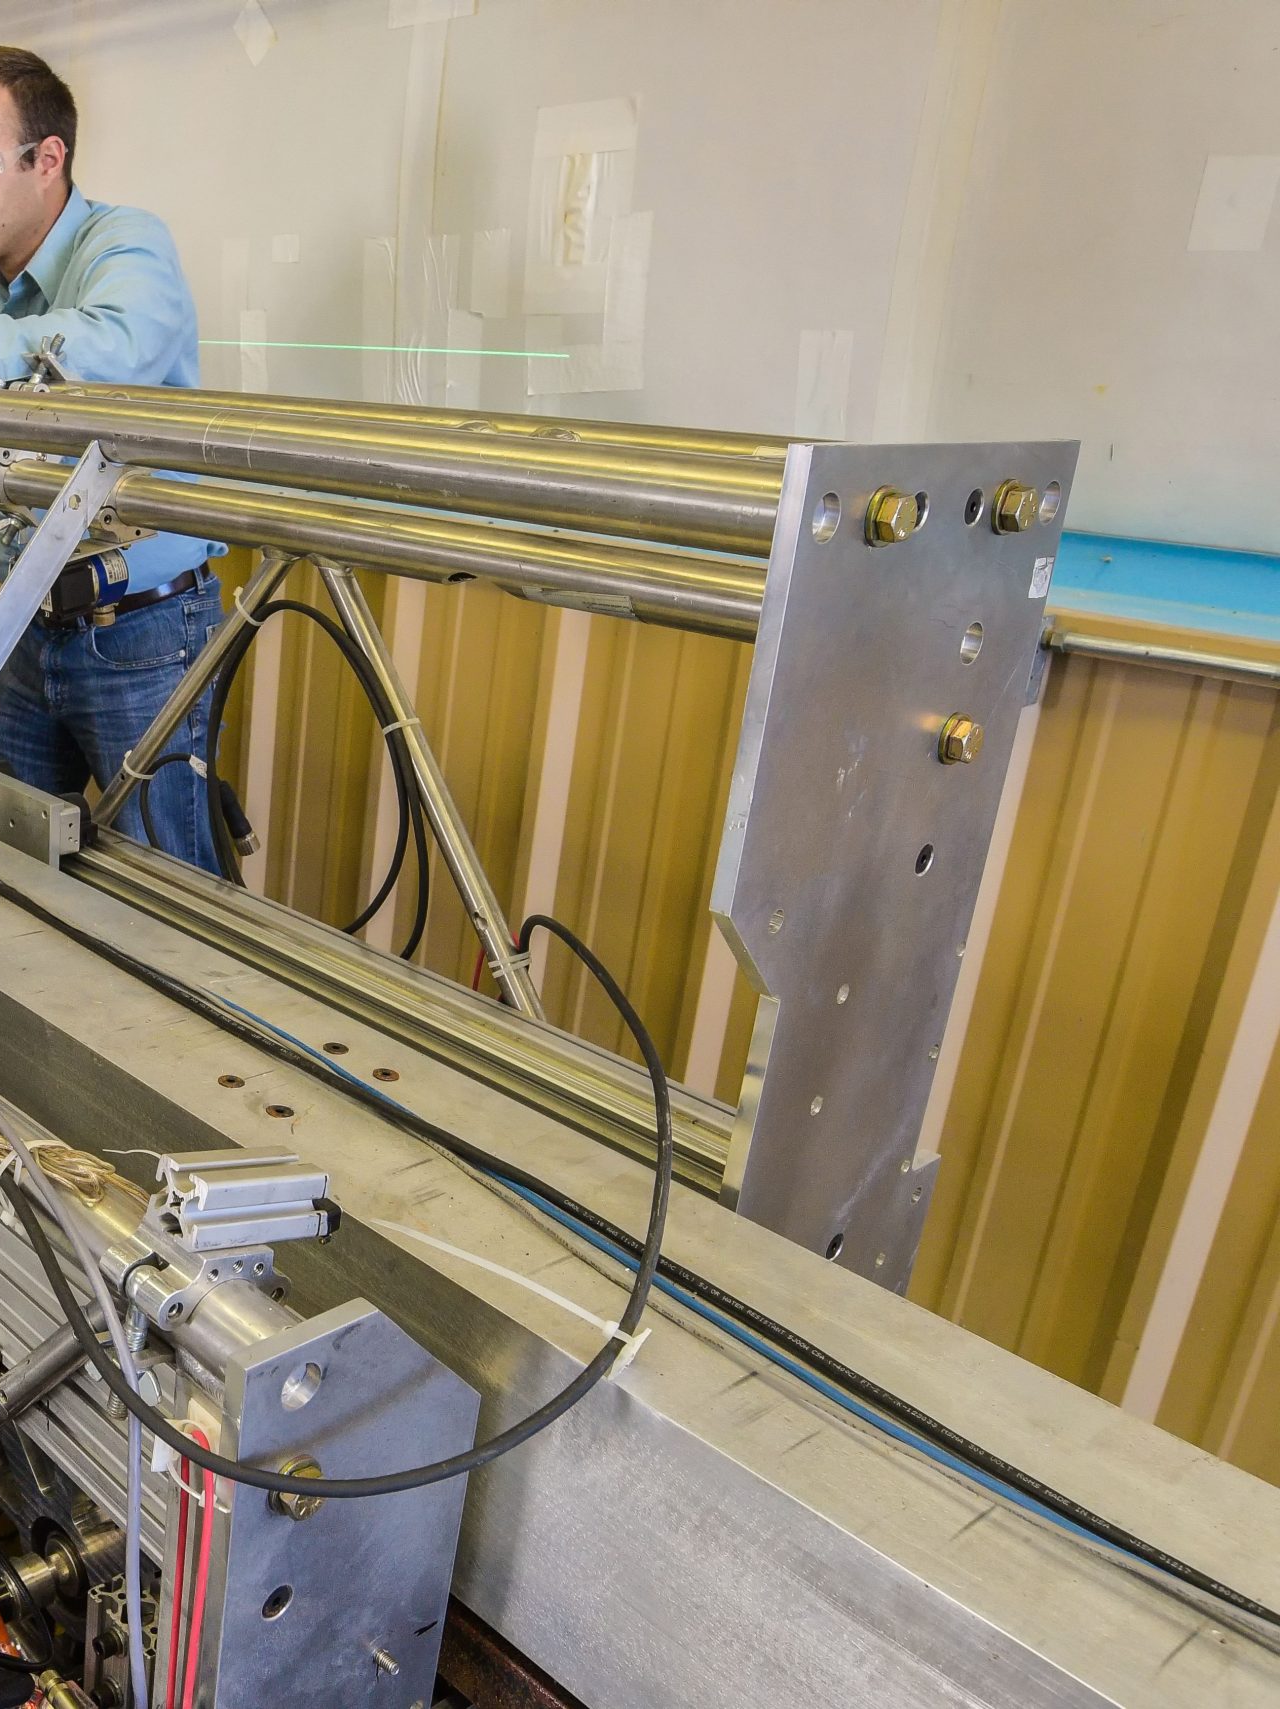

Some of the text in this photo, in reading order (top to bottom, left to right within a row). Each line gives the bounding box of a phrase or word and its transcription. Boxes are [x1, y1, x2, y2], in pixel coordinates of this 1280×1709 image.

[722, 1296, 744, 1311] WATER
[747, 1309, 786, 1335] RESISTANT
[990, 1456, 1014, 1472] VOLT
[1044, 1489, 1071, 1506] MADE
[1075, 1507, 1088, 1517] IN
[1090, 1516, 1110, 1529] USA
